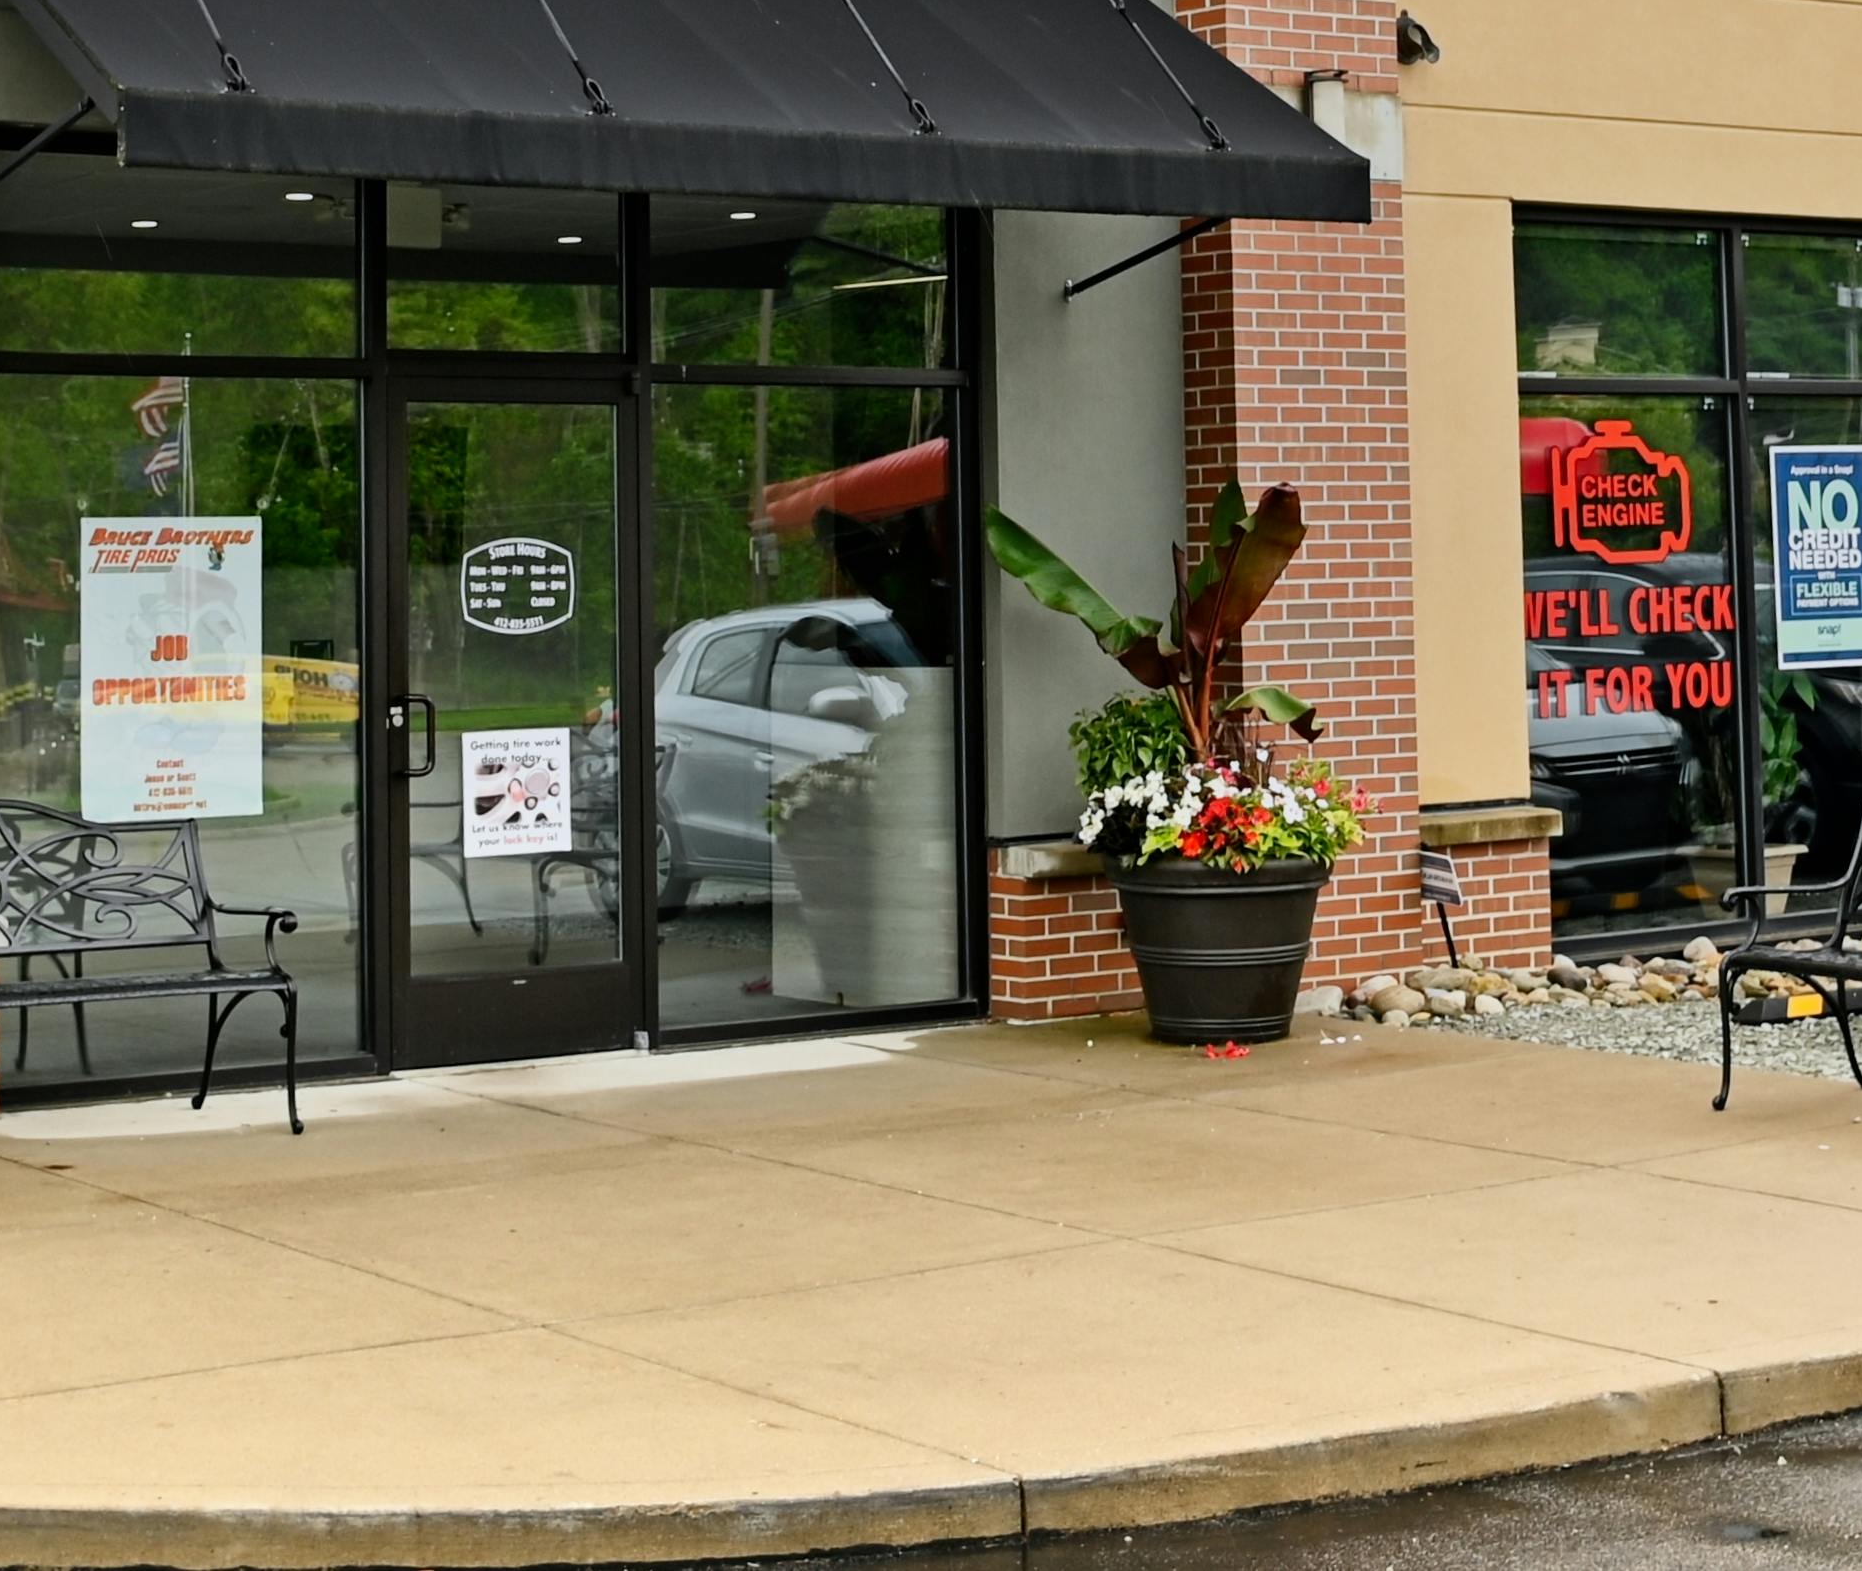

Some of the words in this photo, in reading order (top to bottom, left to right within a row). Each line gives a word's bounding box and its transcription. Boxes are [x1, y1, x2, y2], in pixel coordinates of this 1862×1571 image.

[1581, 474, 1659, 499] CHECK
[1582, 502, 1665, 527] ENGINE
[1787, 479, 1859, 530] NO
[88, 527, 154, 547] BRUCE
[155, 527, 255, 547] BROTHERS
[1788, 528, 1862, 551] CREDIT
[91, 549, 133, 574] TIRE
[129, 549, 181, 574] PROS
[488, 544, 516, 561] STORE
[517, 542, 547, 560] HOURS
[1788, 549, 1862, 571] NEEDED
[1796, 580, 1859, 598] FLEXIBLE
[1524, 588, 1620, 639] WE'LL
[1629, 584, 1736, 635] CHECK
[150, 634, 188, 662] JOB
[92, 675, 247, 706] OPPORTUNITIES
[1537, 670, 1573, 719] IT
[1585, 665, 1656, 717] FOR
[1665, 660, 1733, 710] YOU
[470, 738, 510, 751] Getting
[513, 738, 531, 748] tire
[534, 737, 561, 747] work
